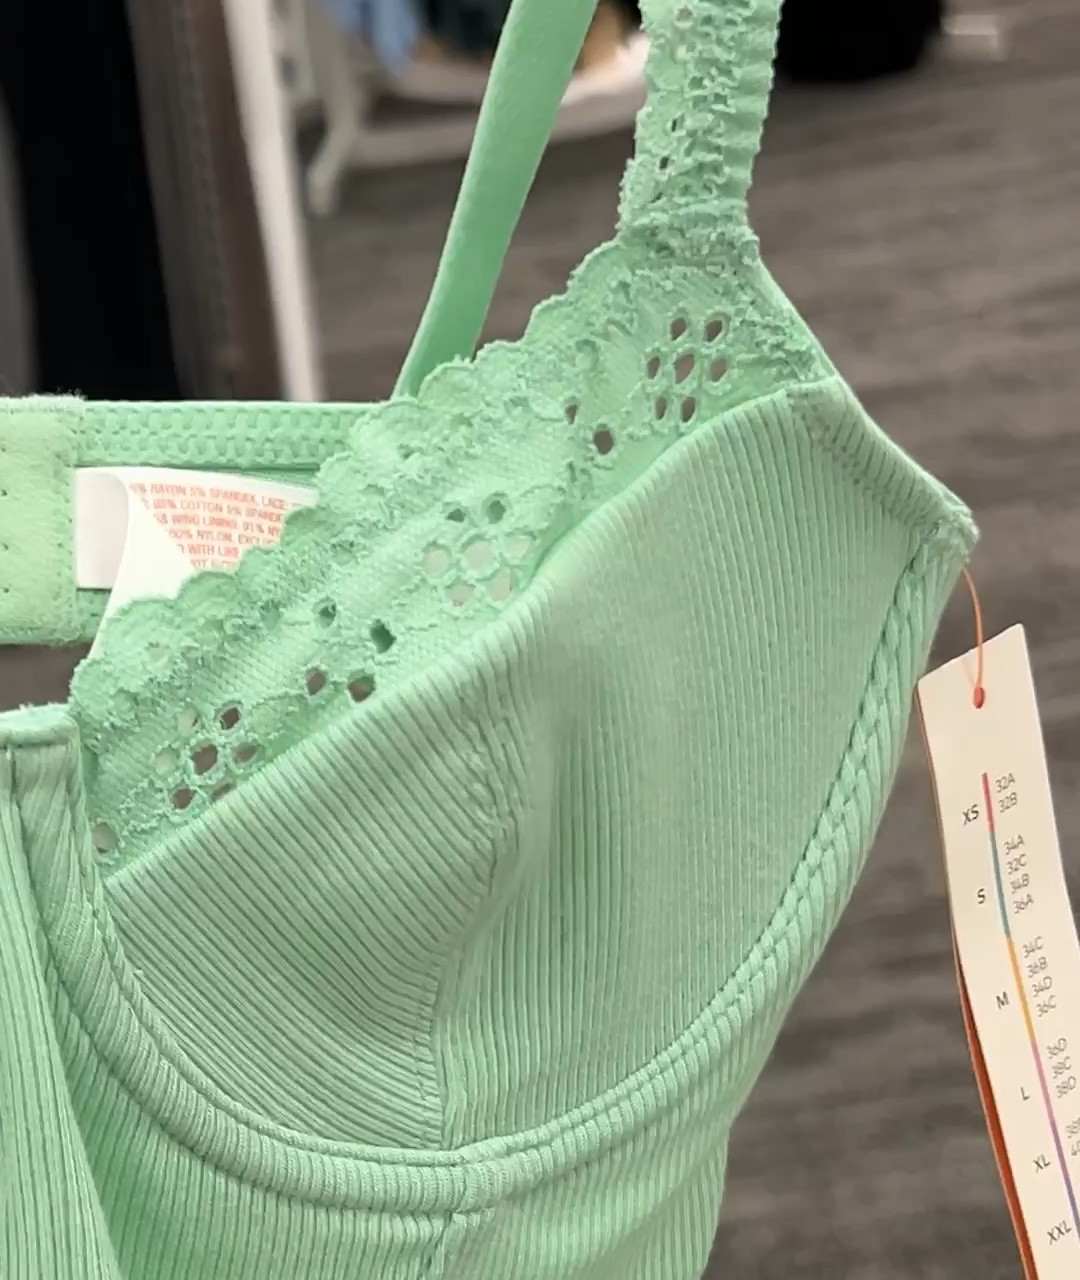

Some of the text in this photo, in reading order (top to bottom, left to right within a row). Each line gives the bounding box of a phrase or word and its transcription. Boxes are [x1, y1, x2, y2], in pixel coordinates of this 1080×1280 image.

[180, 499, 223, 513] COTTON
[187, 543, 216, 556] WITH
[995, 772, 1016, 793] 32A
[998, 791, 1018, 813] 32B
[962, 803, 980, 826] XS
[976, 888, 986, 904] S
[996, 991, 1009, 1009] M
[1020, 1086, 1030, 1101] L
[1033, 1153, 1051, 1174] XL
[1046, 1219, 1072, 1246] XXL
